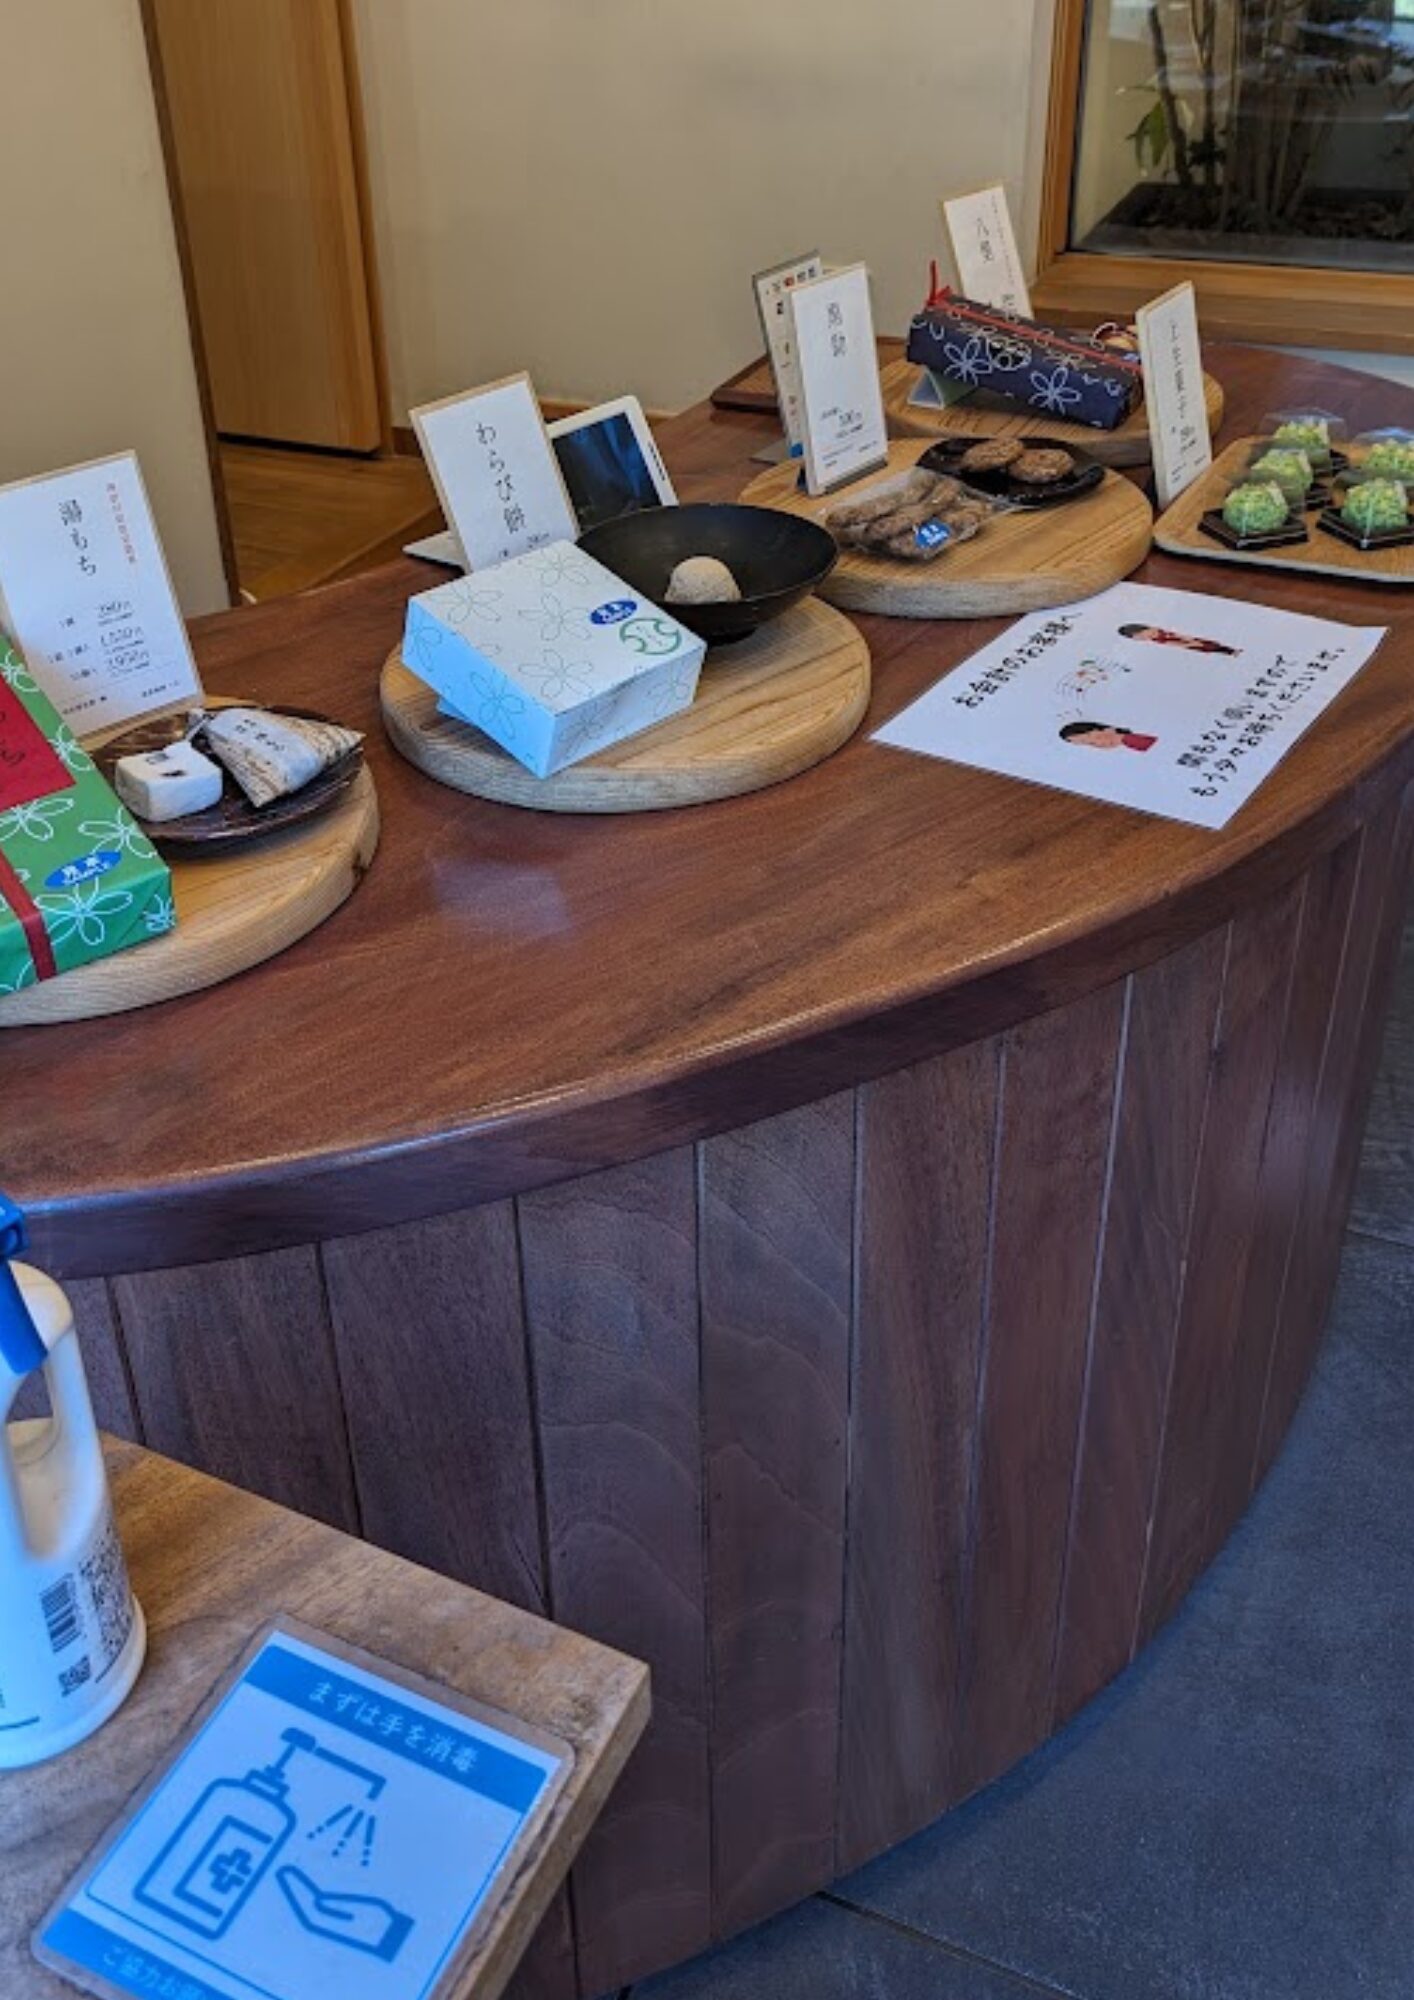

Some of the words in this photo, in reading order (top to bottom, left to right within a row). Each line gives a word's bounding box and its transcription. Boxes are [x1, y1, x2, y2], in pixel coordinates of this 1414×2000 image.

[476, 422, 526, 534] わらび餅
[58, 499, 96, 577] 湯もち
[951, 611, 1083, 708] お会計のお客様へ
[309, 1681, 478, 1773] まずは手を消毒
